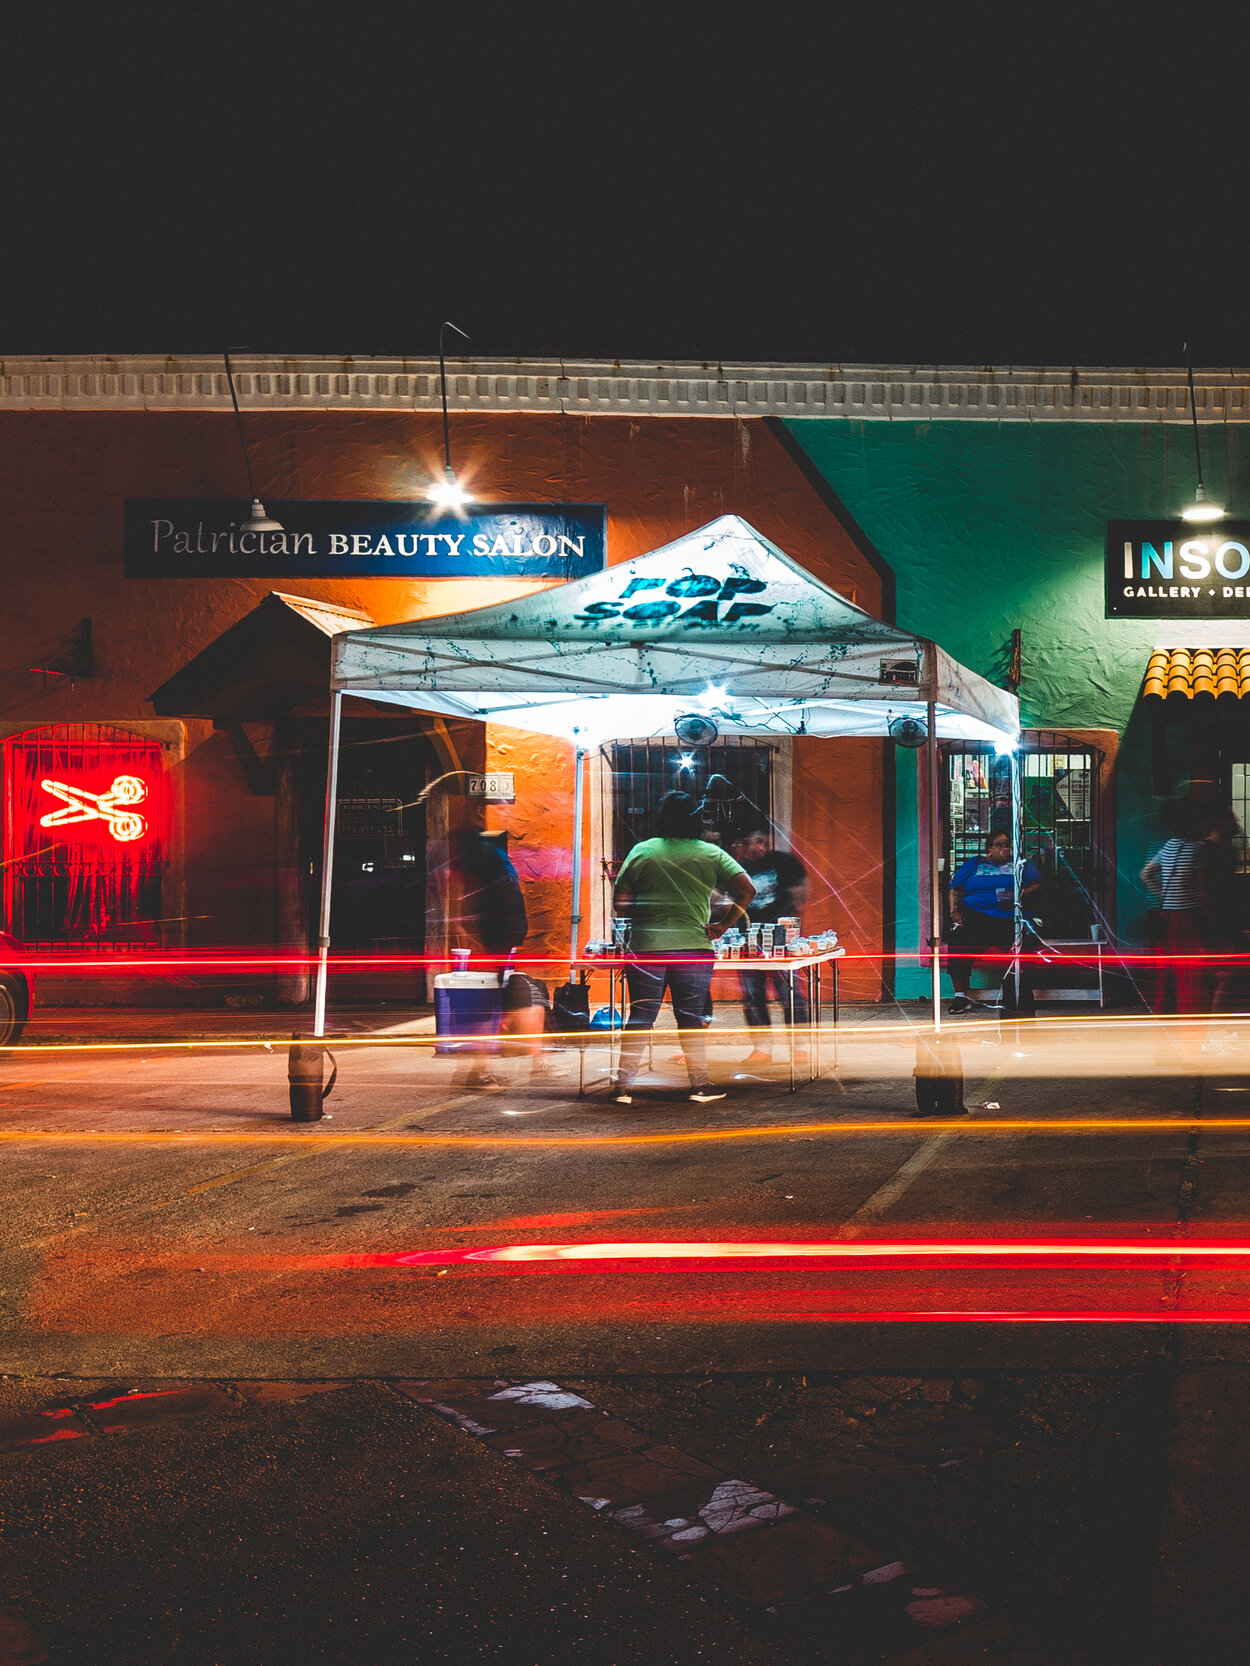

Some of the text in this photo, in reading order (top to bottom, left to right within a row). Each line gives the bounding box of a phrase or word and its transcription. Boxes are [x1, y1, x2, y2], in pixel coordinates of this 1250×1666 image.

[150, 518, 587, 558] Patrician BEAUTY SALON
[1122, 585, 1202, 599] GALLERY
[573, 599, 776, 623] SOAP
